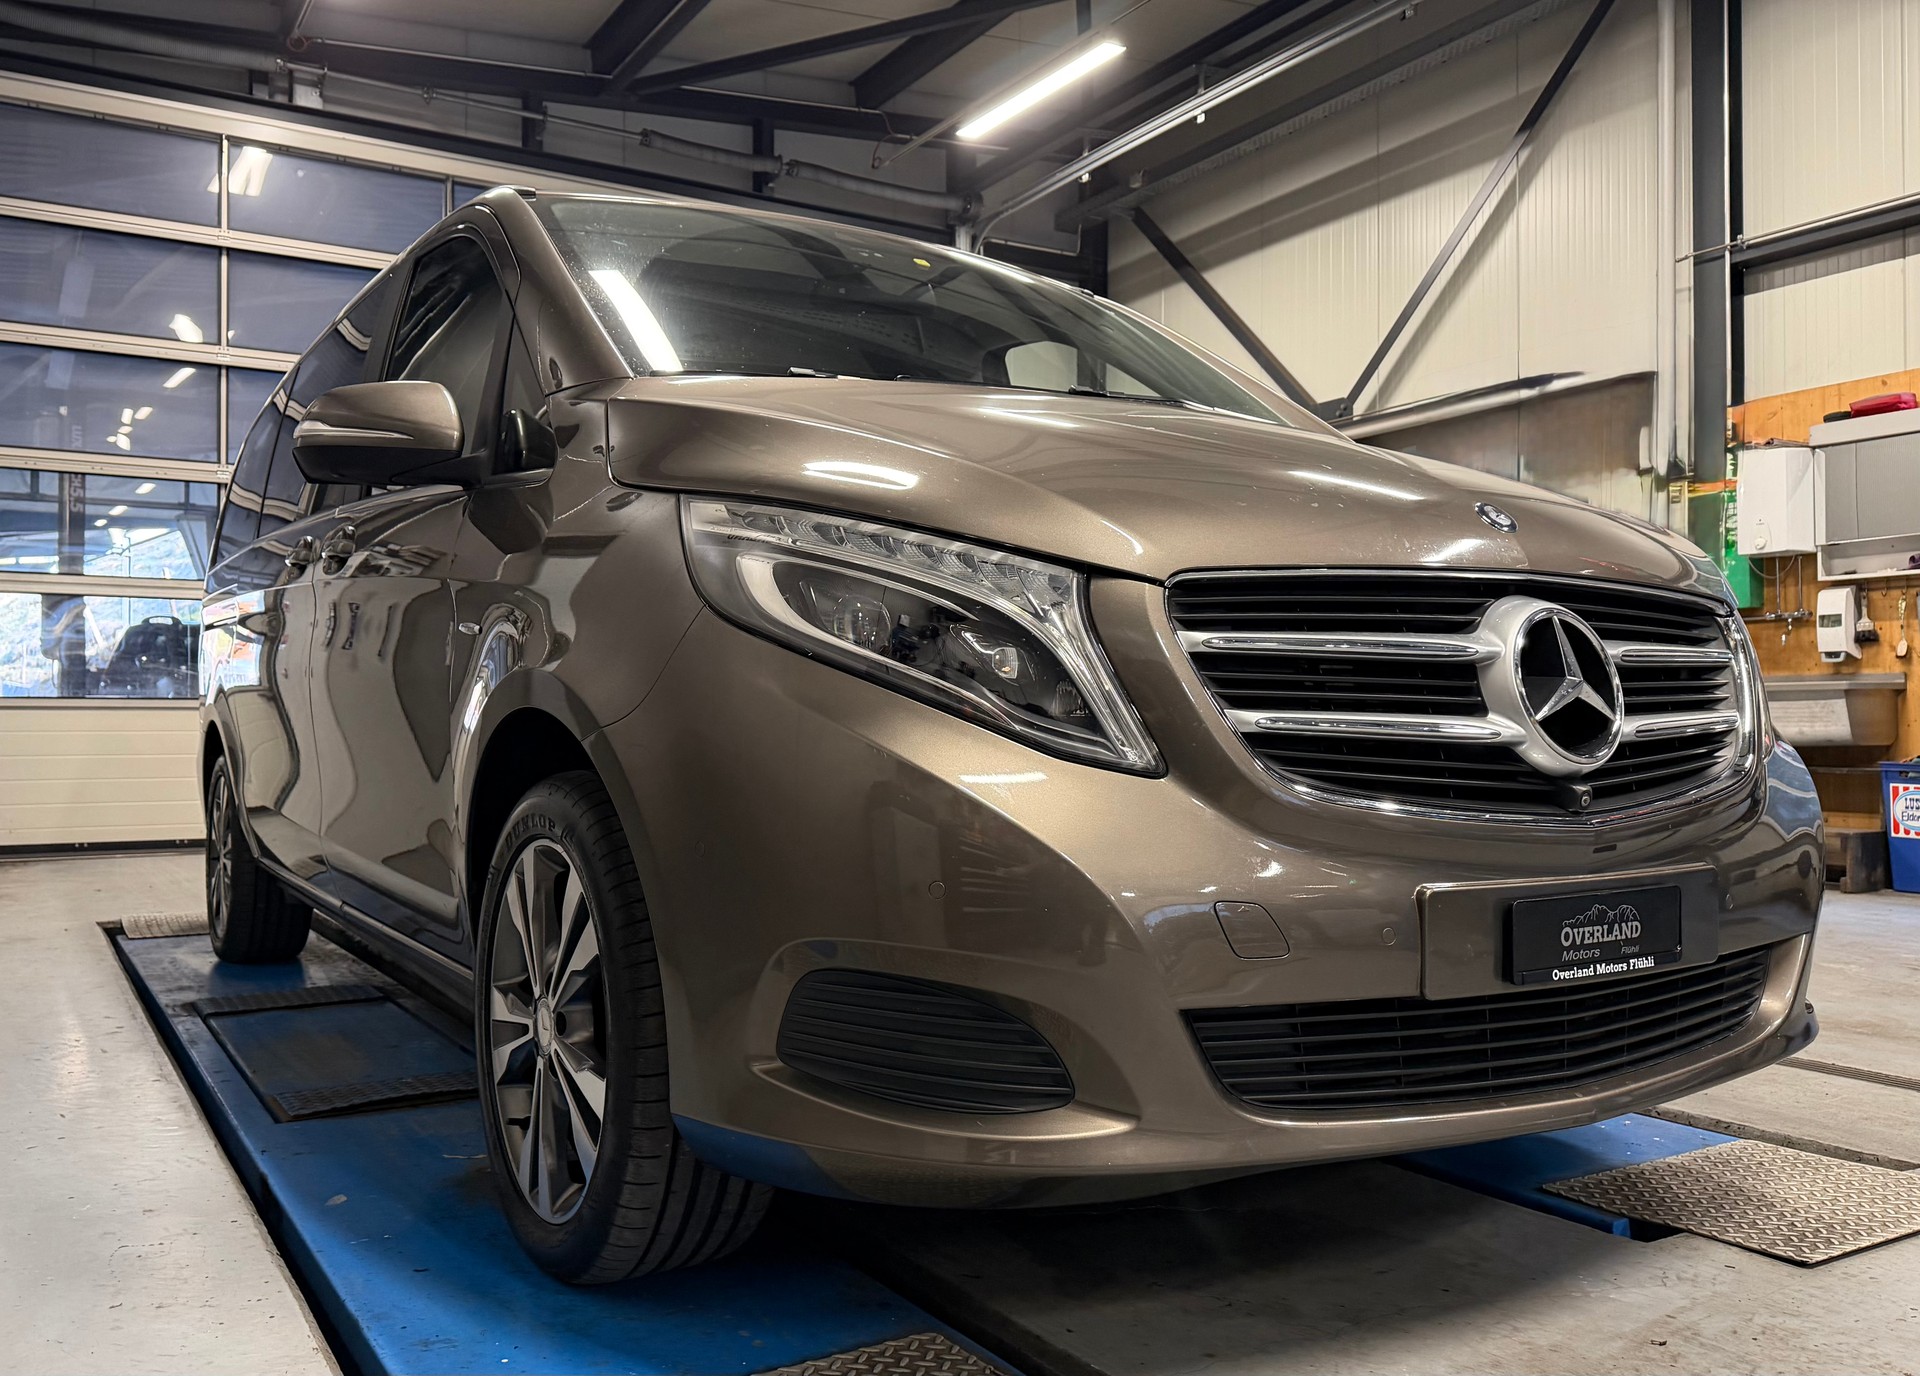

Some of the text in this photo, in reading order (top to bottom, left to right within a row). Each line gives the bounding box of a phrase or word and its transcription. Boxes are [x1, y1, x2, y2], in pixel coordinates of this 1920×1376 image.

[504, 813, 556, 849] DUNLOP
[1562, 948, 1600, 962] Motors
[1552, 956, 1655, 981] Overland Motors Flühli
